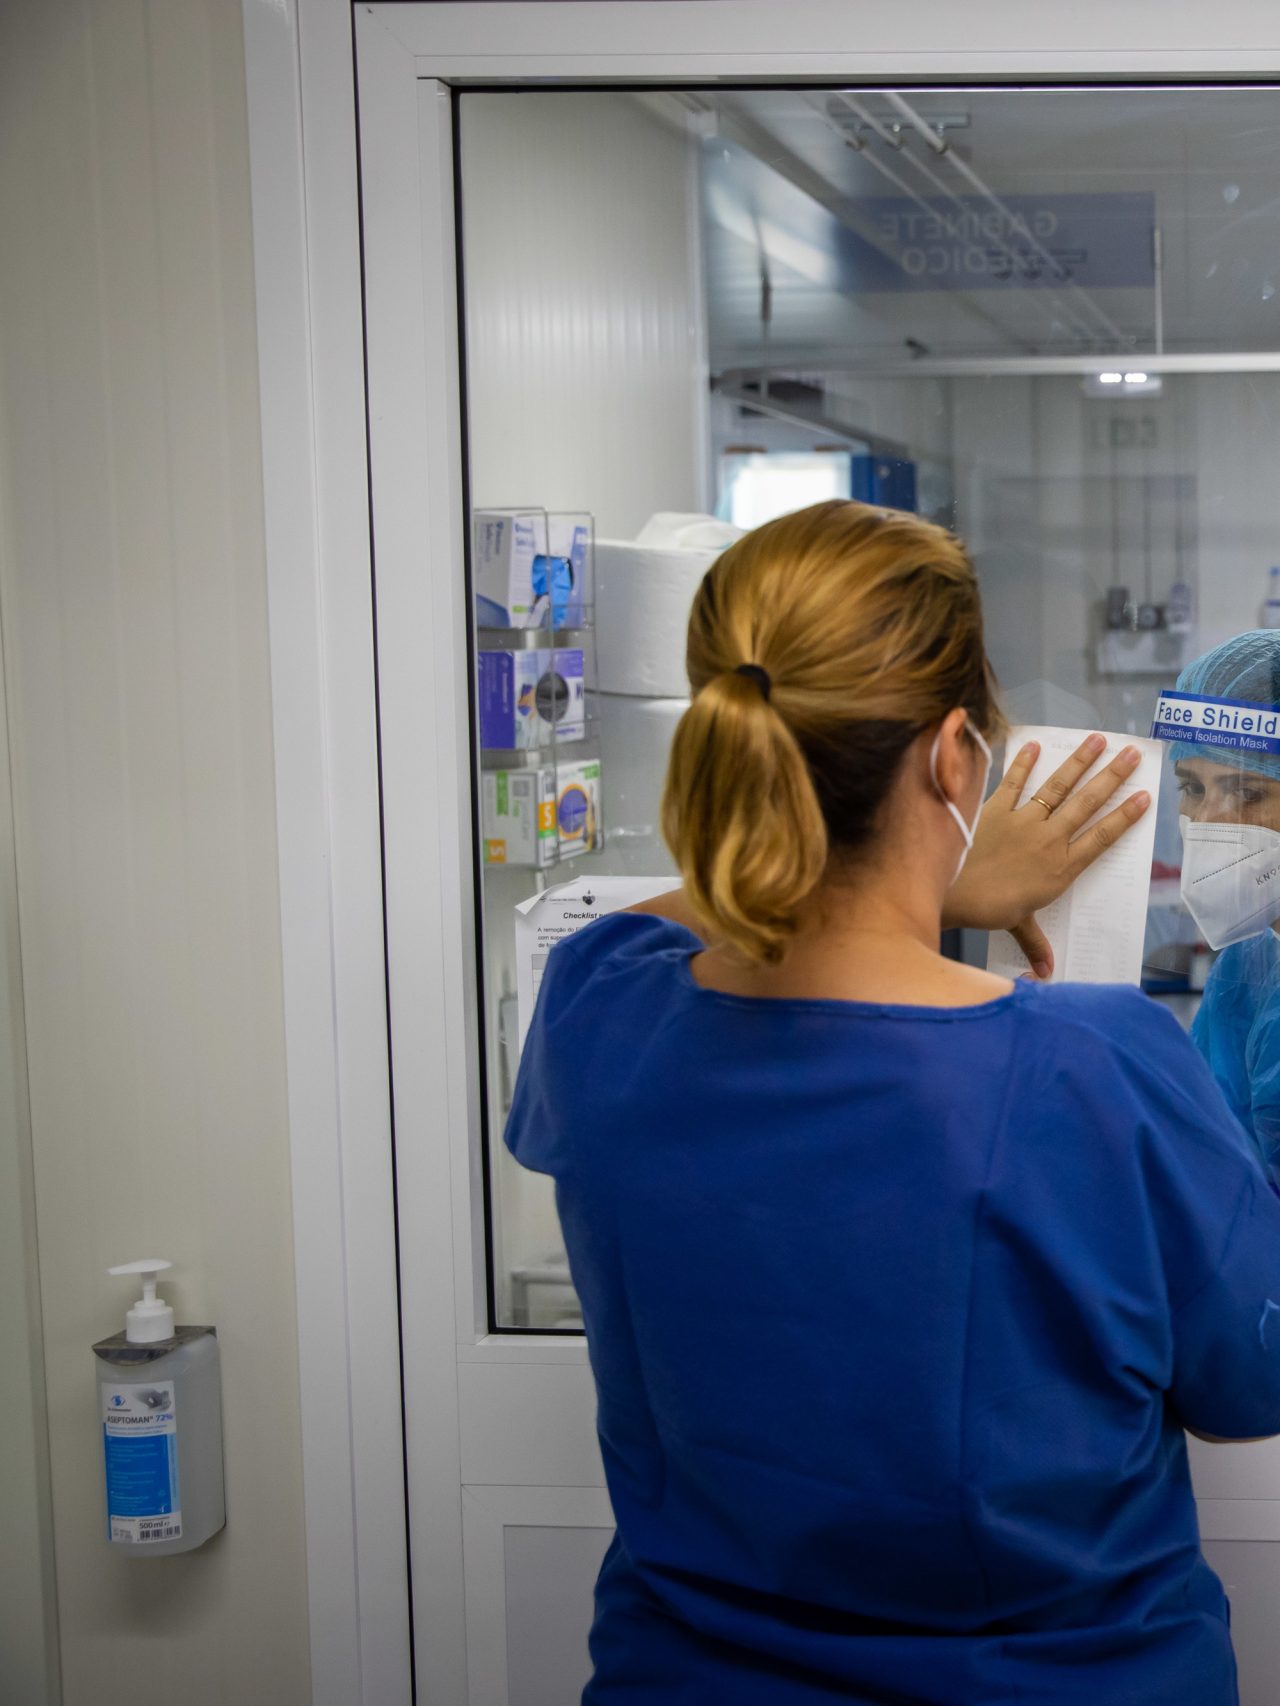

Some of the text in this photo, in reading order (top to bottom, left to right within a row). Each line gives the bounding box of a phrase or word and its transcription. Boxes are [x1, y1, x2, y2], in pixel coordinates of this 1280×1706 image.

[1158, 702, 1277, 735] Face Shield
[1159, 725, 1268, 750] Protective Isolation Mask
